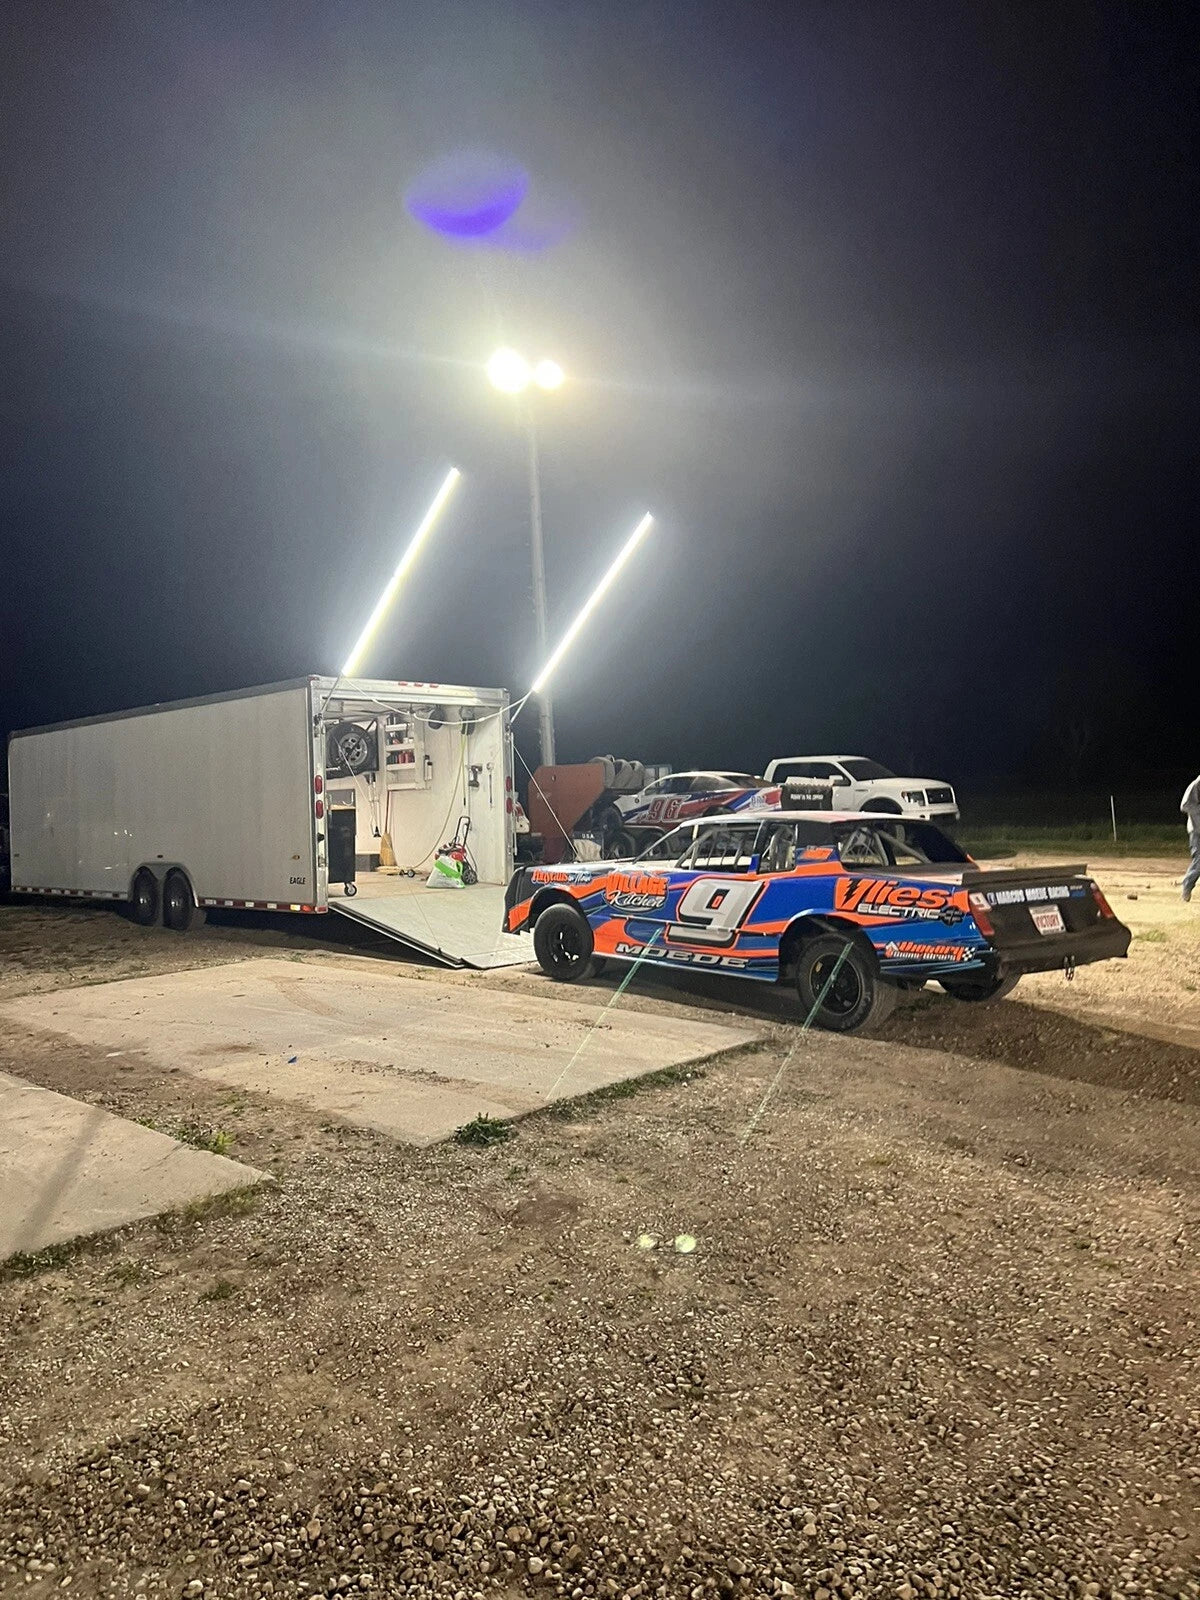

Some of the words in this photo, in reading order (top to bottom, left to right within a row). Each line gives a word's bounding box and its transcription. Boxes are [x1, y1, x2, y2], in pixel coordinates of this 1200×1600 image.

[289, 876, 306, 885] EAGLE
[605, 871, 668, 900] VILLAGE
[609, 890, 665, 909] Kitchen
[667, 877, 765, 942] 9
[857, 902, 941, 920] ELECTRIC
[615, 942, 749, 970] MOEDE
